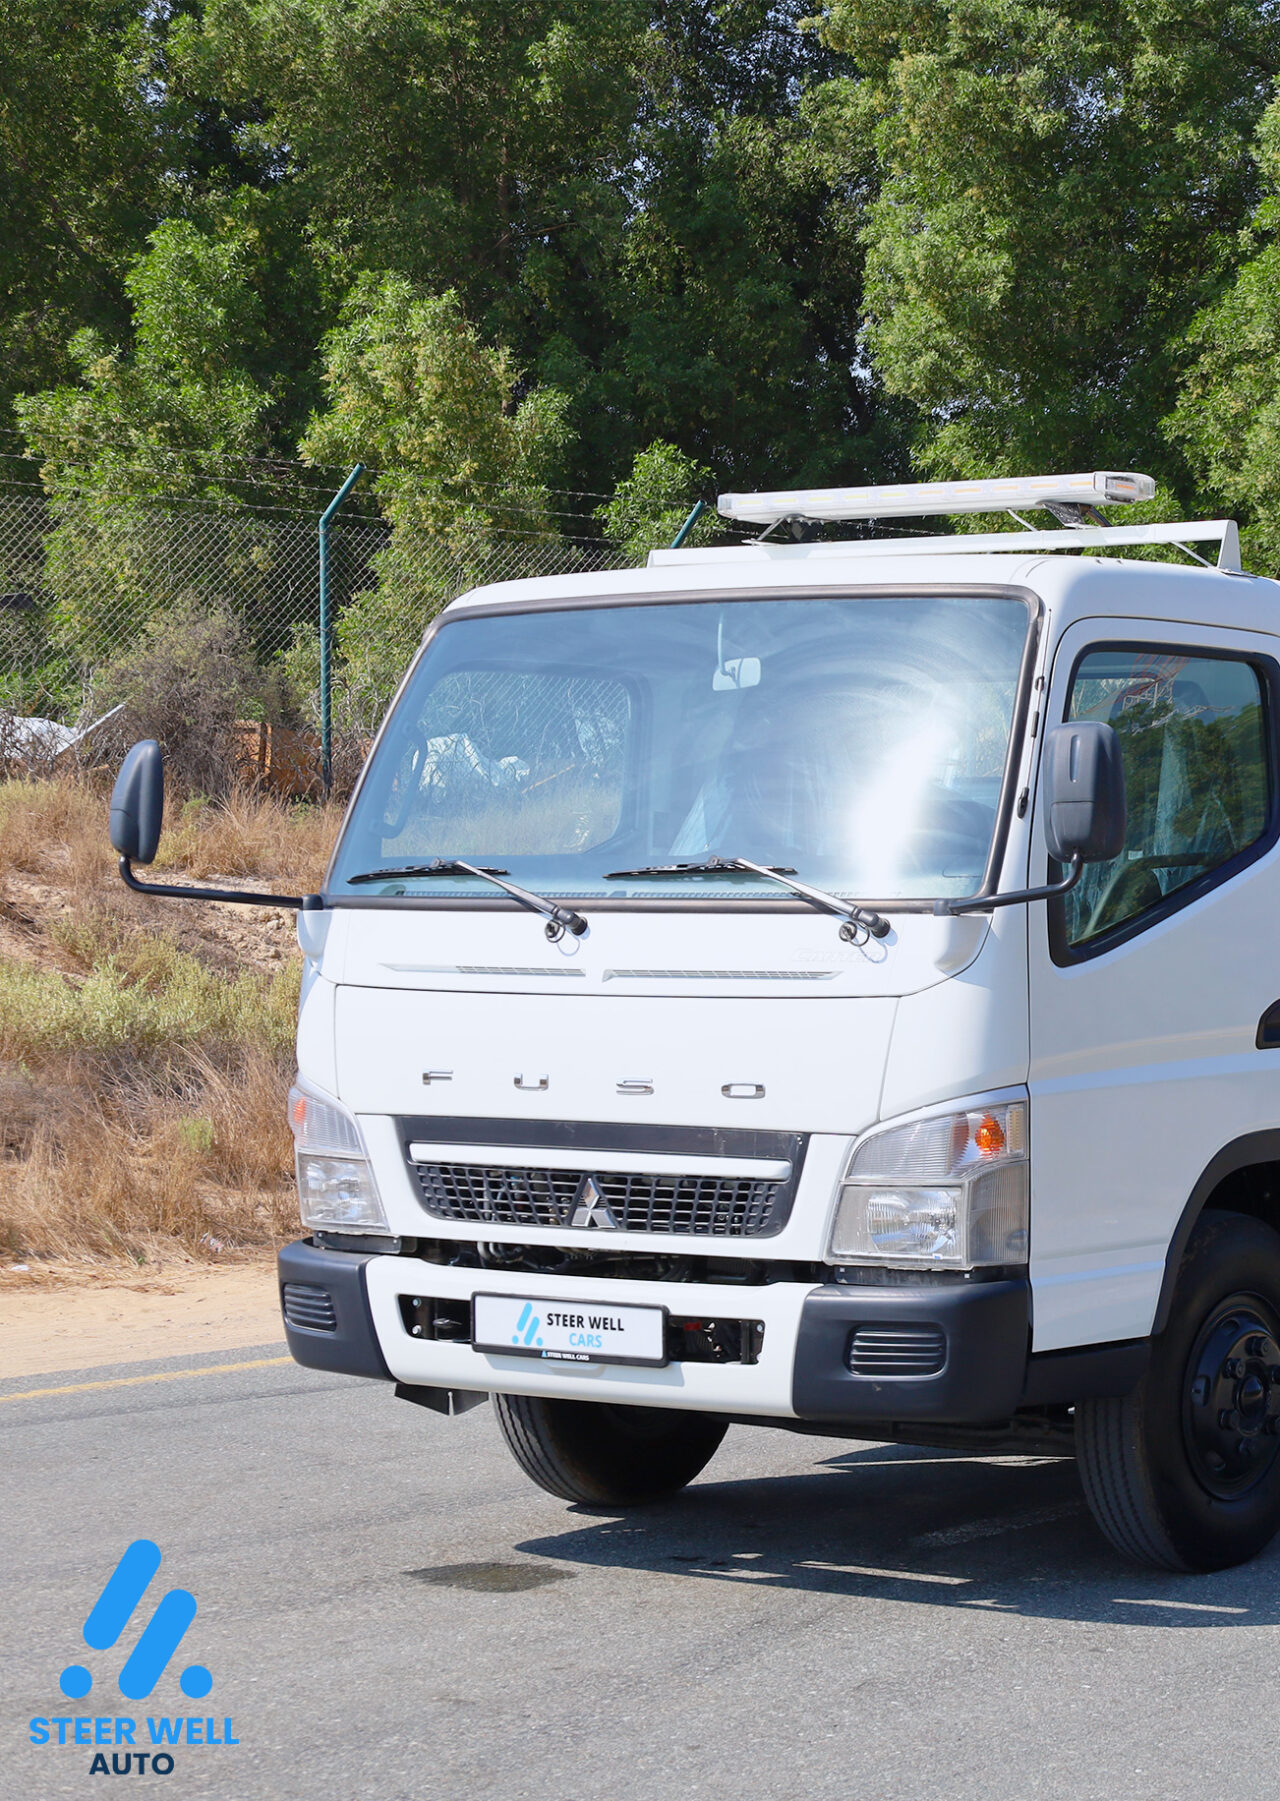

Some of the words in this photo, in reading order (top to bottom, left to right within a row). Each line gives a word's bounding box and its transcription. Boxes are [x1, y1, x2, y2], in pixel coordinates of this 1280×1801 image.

[422, 1070, 766, 1099] FUSO
[547, 1313, 584, 1328] STEER
[588, 1316, 624, 1331] WELL
[569, 1333, 602, 1348] CARS
